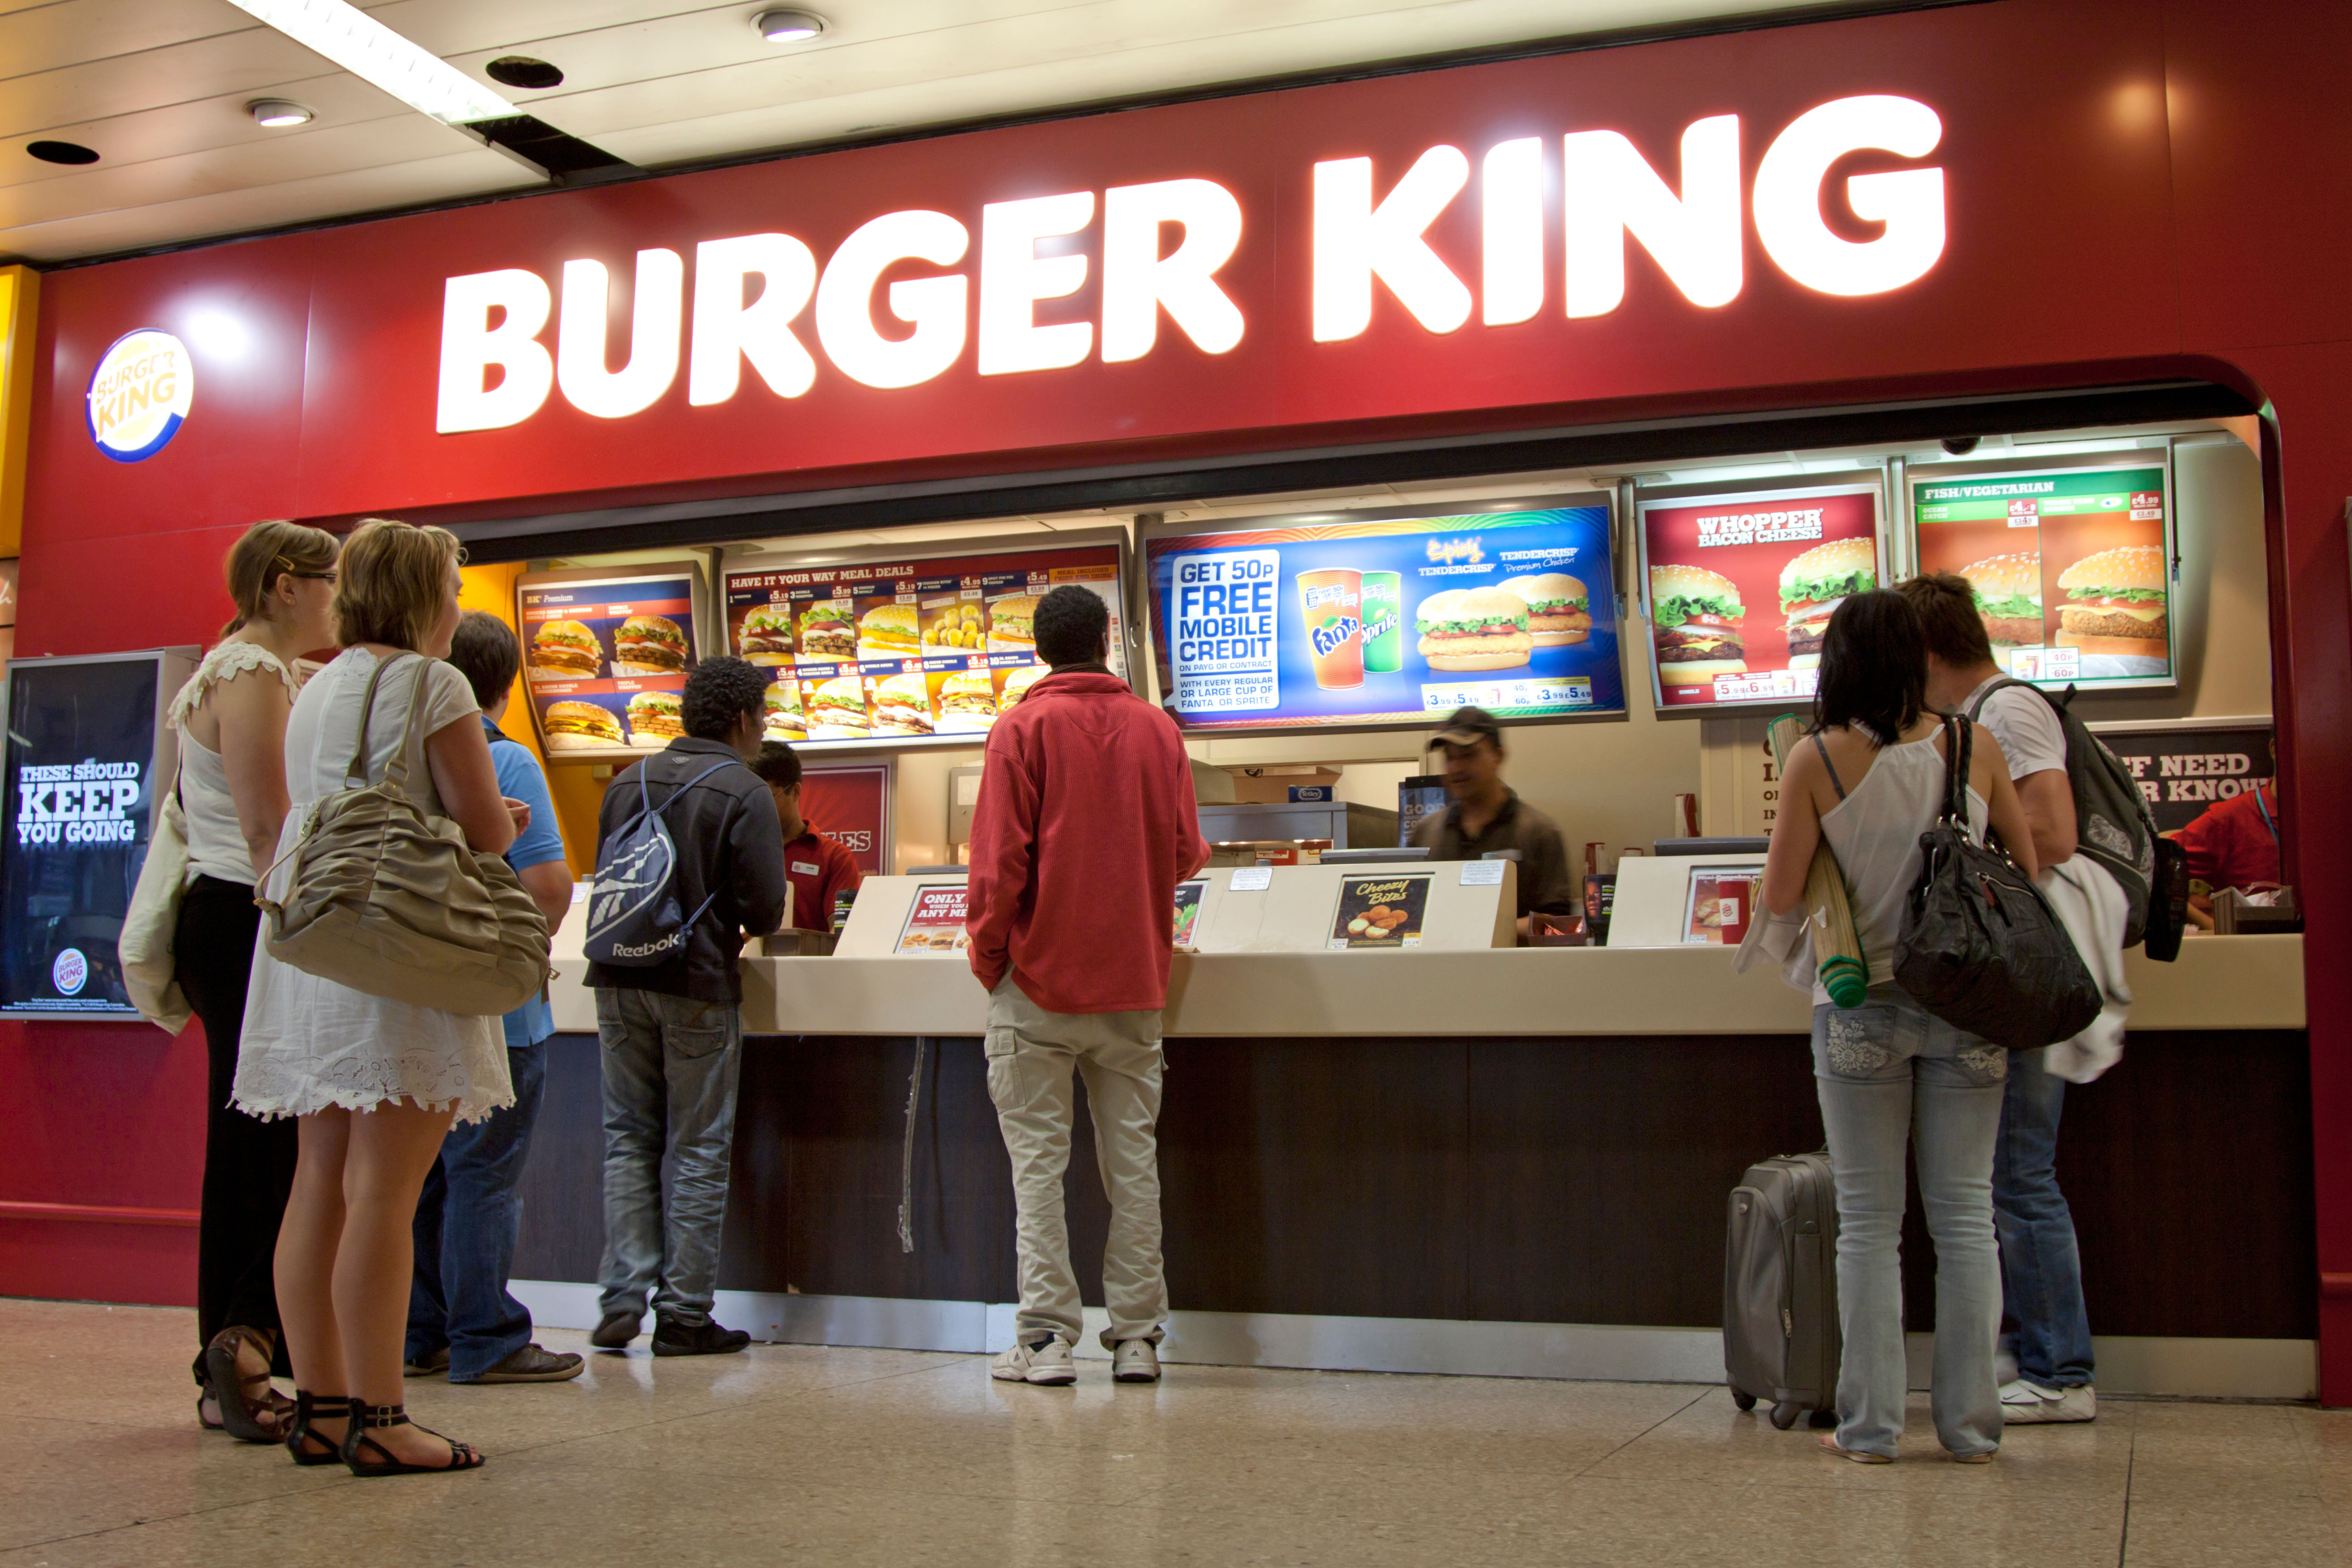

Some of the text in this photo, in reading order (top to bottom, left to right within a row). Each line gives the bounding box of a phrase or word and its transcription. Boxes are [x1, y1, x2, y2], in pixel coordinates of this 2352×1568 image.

[435, 95, 1946, 435] BURGER KING
[96, 351, 175, 405] BURGER
[98, 372, 175, 440] KING
[1925, 482, 2054, 499] FISH/VEGETARIAN
[2132, 494, 2159, 504] £4.99
[1697, 509, 1821, 534] WHOPPER
[1698, 526, 1822, 547] BACON CHEESE
[1427, 538, 1484, 564] Spicy
[1500, 548, 1577, 560] TENDERCRISP
[1181, 561, 1226, 583] GET
[1418, 565, 1494, 576] TENDERCRISP
[1504, 557, 1575, 572] Premium Chicken
[731, 566, 914, 588] HAVE IT YOUR WAY MEAL DEALS
[961, 577, 981, 586] £4.99
[982, 577, 988, 585] 9
[1027, 572, 1047, 581] £5.49
[832, 586, 851, 594] £5.99
[896, 581, 915, 590] £5.19
[769, 590, 789, 600] £5.19
[1181, 581, 1272, 617] FREE
[1180, 615, 1272, 640] MOBILE
[1362, 609, 1397, 646] Sprite
[1312, 616, 1359, 657] Fanta
[1179, 637, 1272, 662] CREDIT
[968, 656, 988, 665] £5.19
[990, 657, 1000, 665] 10
[1230, 661, 1272, 669] CONTRACT
[777, 668, 795, 676] £5.49
[859, 665, 866, 673] 6
[1235, 677, 1273, 685] REGULAR
[1717, 682, 1773, 694] £5.99 £6.99
[1181, 690, 1194, 698] OR
[1199, 688, 1231, 696] LARGE
[1236, 686, 1256, 695] CUP
[1427, 694, 1479, 705] £3.99 £5.49
[1537, 687, 1591, 700] £3.99 £5.49
[1182, 699, 1213, 708] FANTA
[1236, 696, 1270, 705] SPRITE
[20, 762, 139, 782] THESE SHOULD
[2160, 753, 2250, 777] NEED
[18, 780, 139, 823] KEEP
[17, 820, 135, 843] YOU GOING
[1356, 880, 1410, 895] Cheezy
[924, 894, 966, 904] ONLY
[1368, 892, 1408, 905] Bites
[613, 934, 679, 957] Reebok
[58, 958, 82, 973] BURGER
[59, 965, 83, 984] KING
